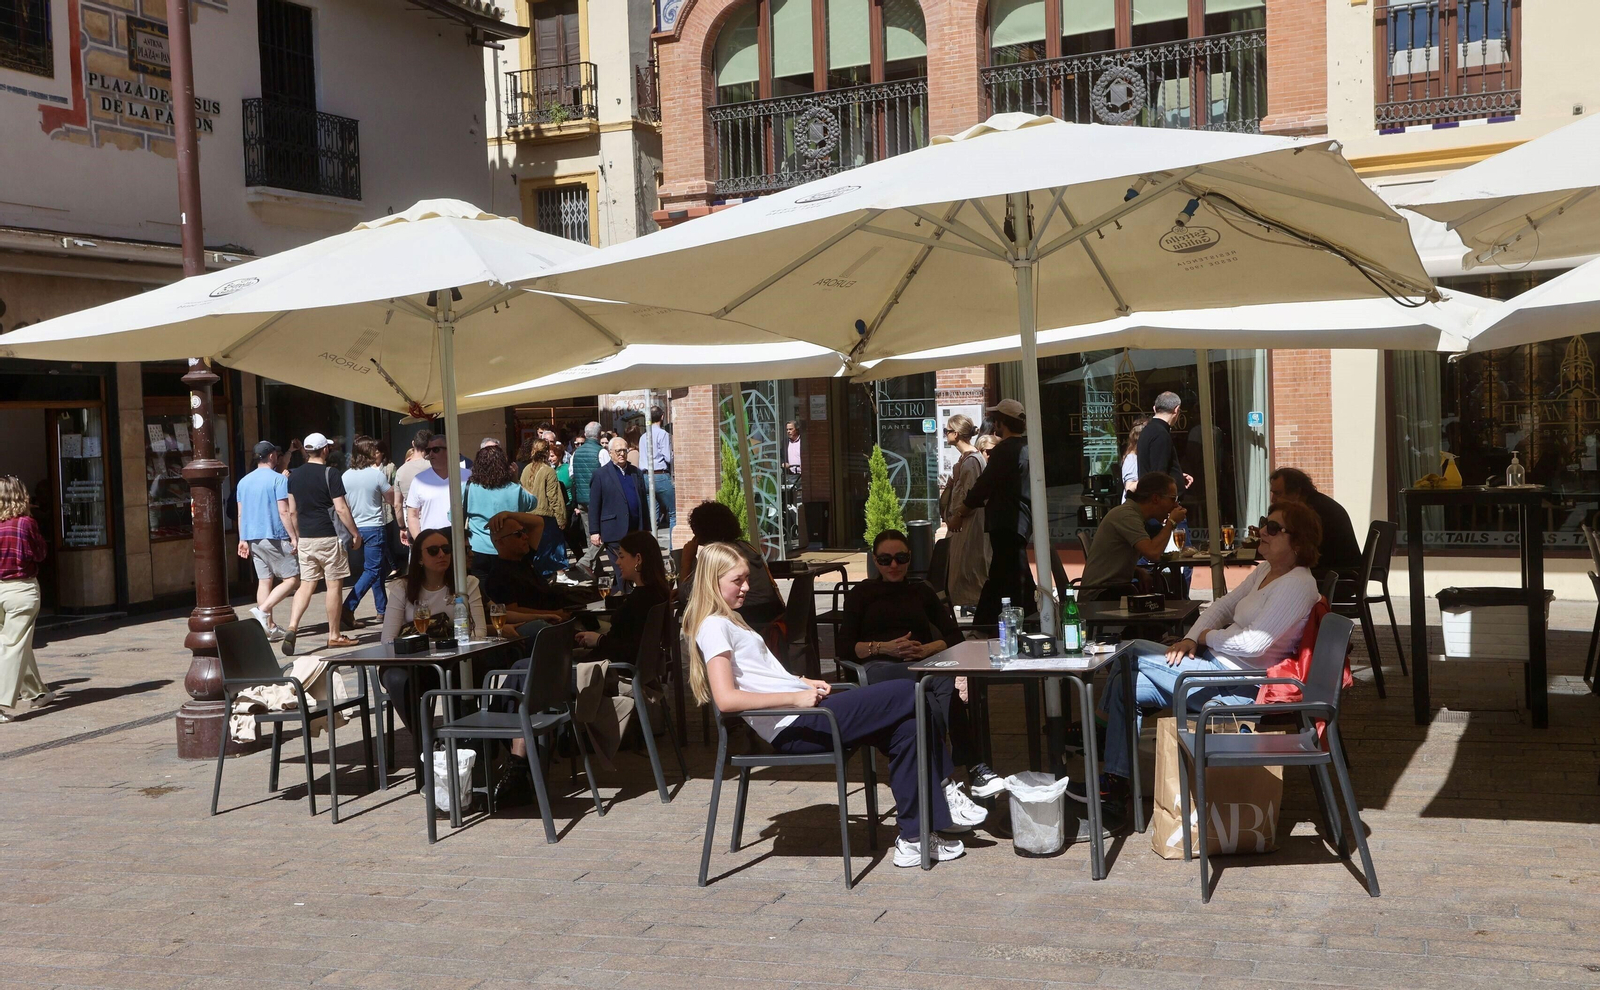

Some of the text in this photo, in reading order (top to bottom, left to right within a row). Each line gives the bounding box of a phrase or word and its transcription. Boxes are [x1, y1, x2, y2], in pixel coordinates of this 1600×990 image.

[138, 46, 156, 60] PLAZA
[161, 52, 171, 63] PAN
[88, 72, 144, 97] PLAZA
[149, 86, 169, 103] DE
[101, 97, 213, 132] DE LA PAON
[1402, 532, 1489, 544] CCKTAILS
